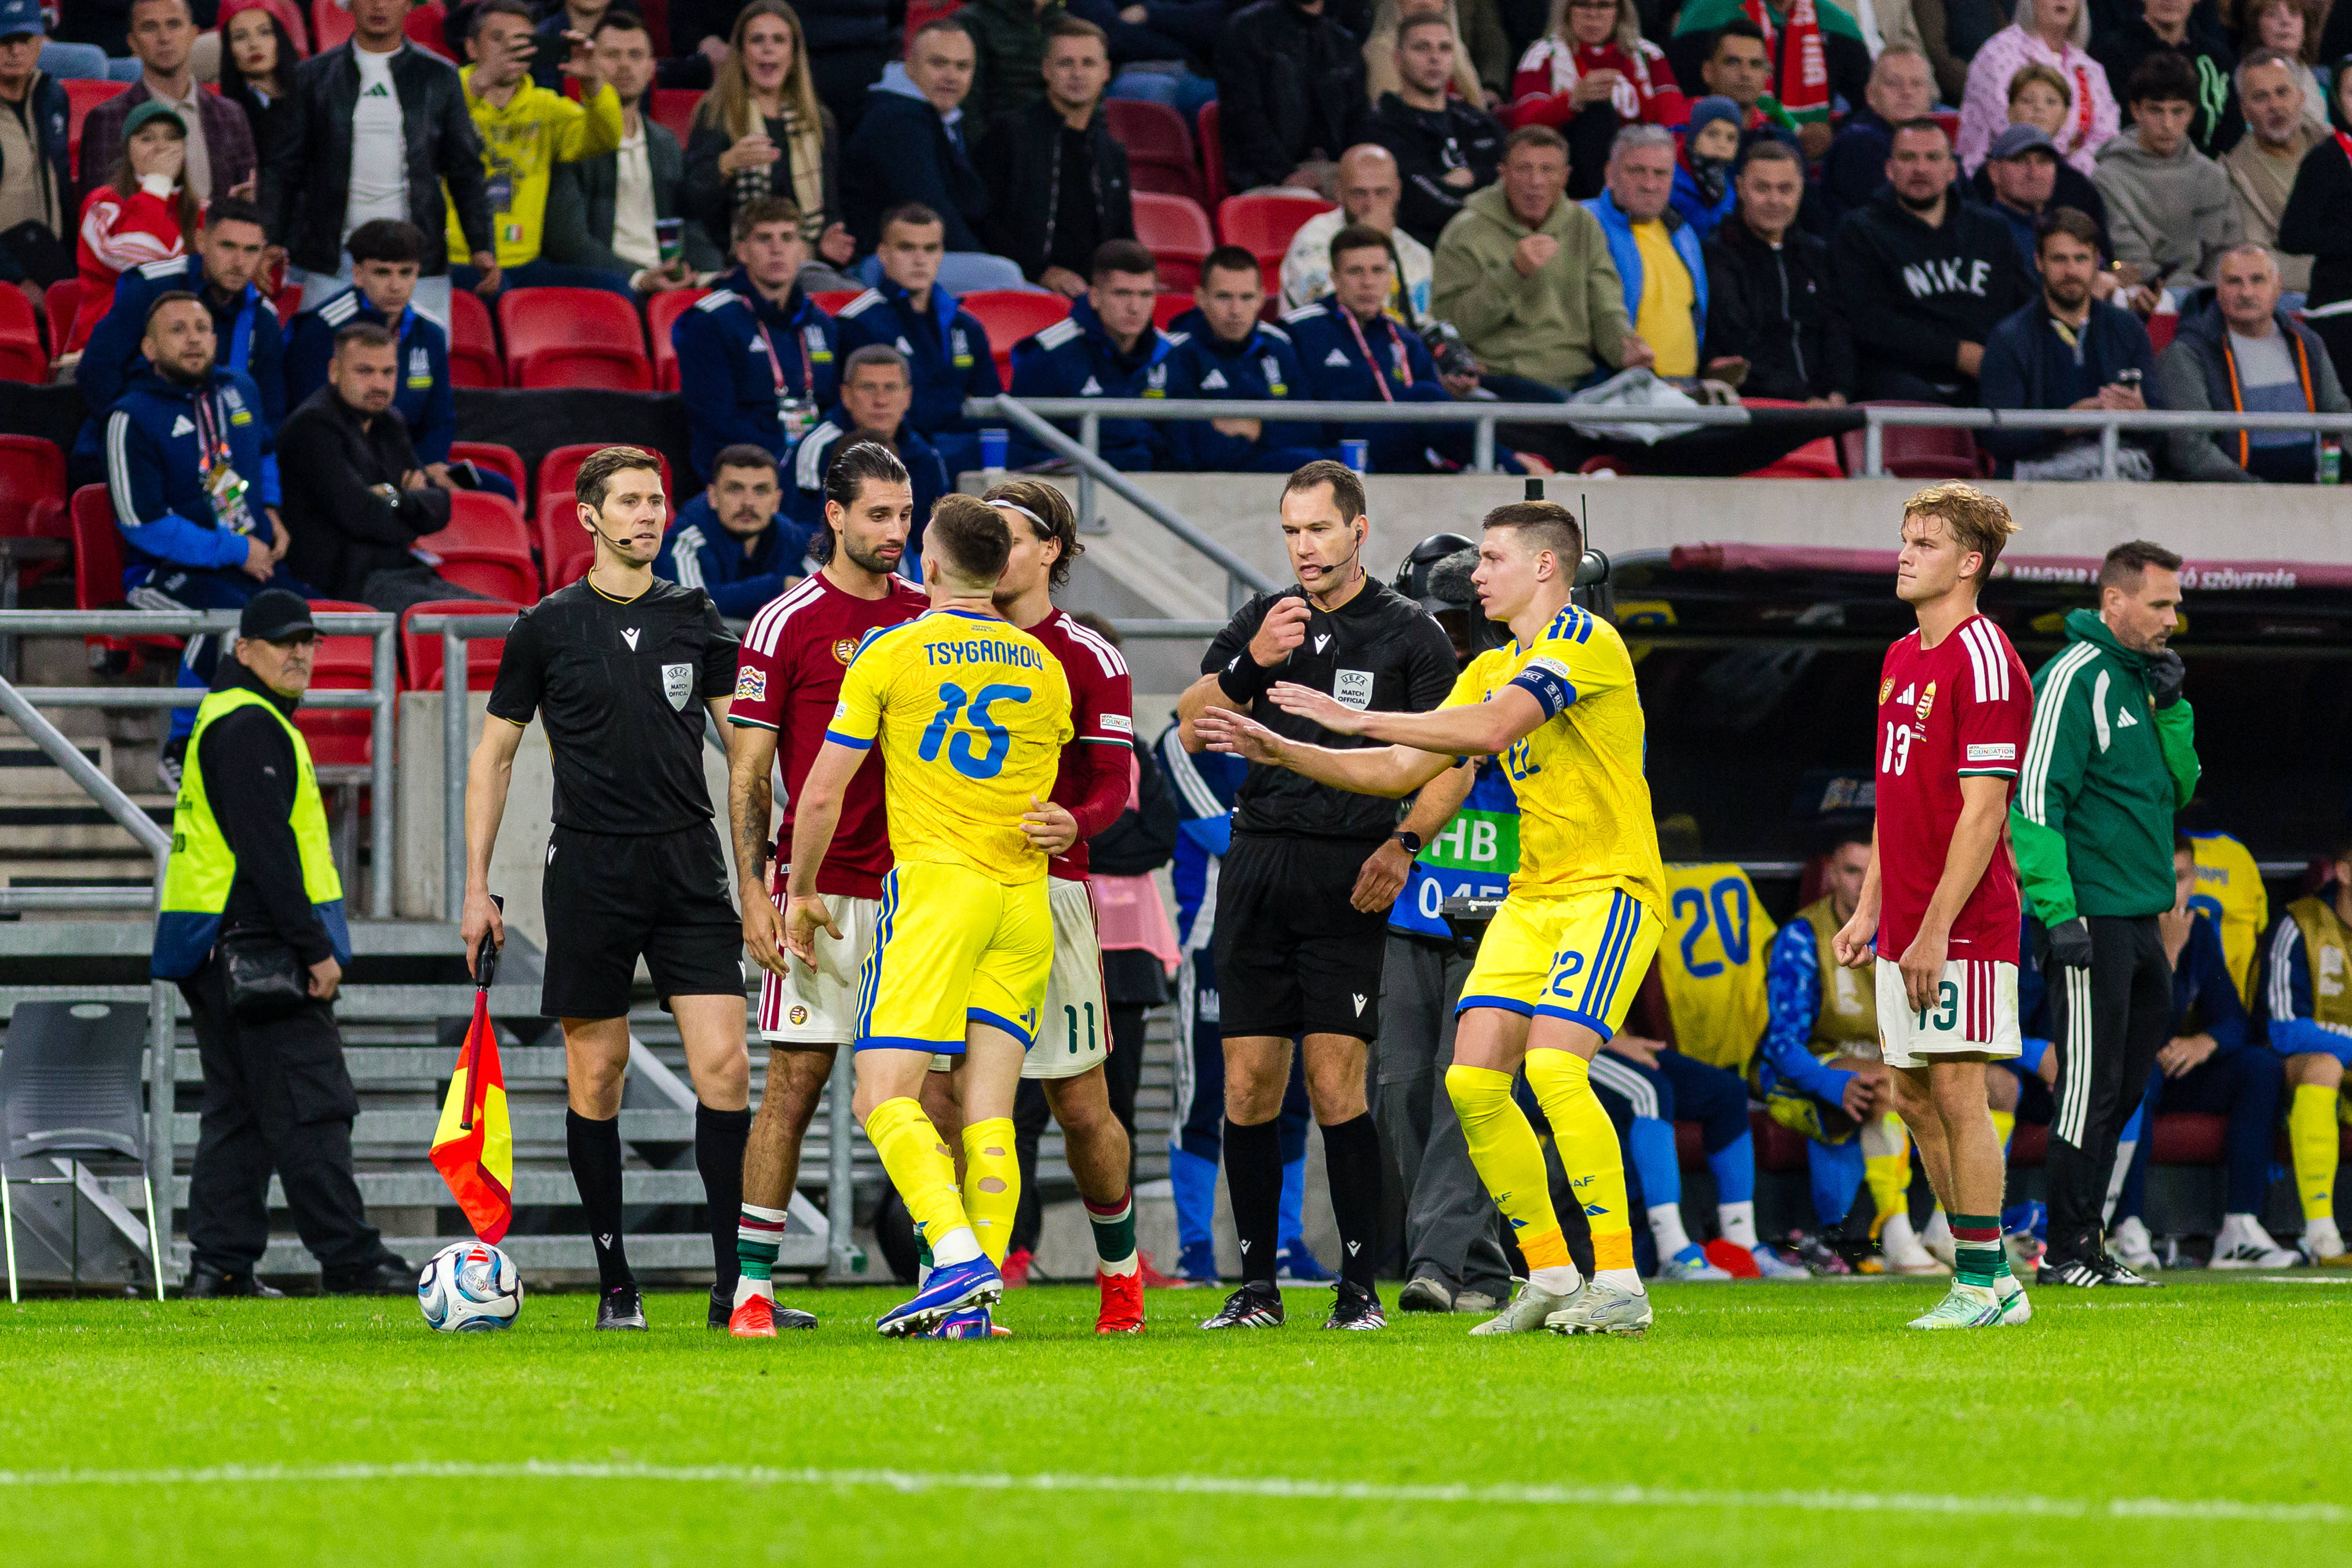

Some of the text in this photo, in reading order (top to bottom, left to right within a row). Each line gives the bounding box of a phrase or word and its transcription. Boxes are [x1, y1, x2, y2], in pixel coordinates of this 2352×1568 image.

[1904, 257, 1991, 298] NIKE
[669, 669, 687, 678] UEFA
[923, 639, 1043, 671] TSYGANKOV
[1338, 696, 1366, 704] OFFICIAL
[1341, 675, 1365, 686] UEFA
[918, 682, 1032, 779] 15
[1102, 719, 1130, 727] FOUNDAT
[1882, 721, 1911, 776] 13
[1432, 818, 1497, 861] HB
[1672, 878, 1750, 979] 20
[1540, 951, 1584, 998] 2
[1064, 1001, 1095, 1054] 11
